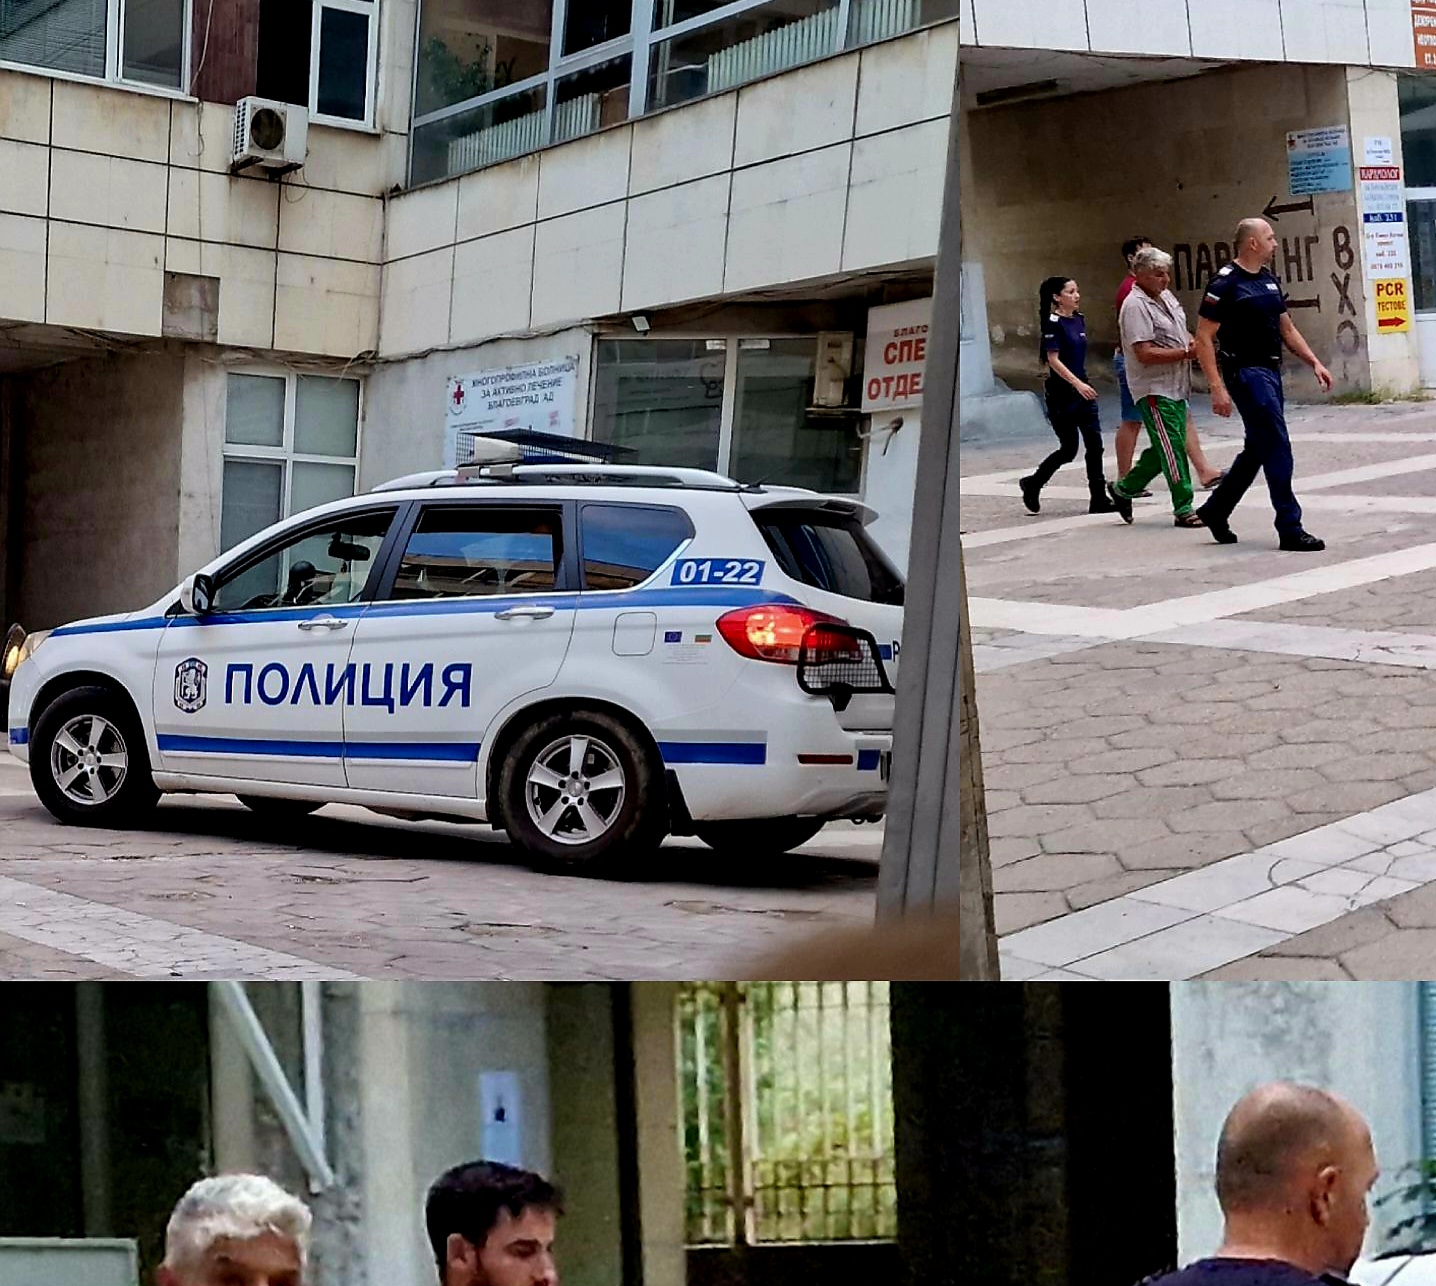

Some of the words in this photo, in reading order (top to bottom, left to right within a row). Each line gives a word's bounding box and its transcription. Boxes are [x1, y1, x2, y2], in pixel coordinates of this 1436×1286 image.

[1173, 235, 1319, 291] ПАРНГ
[1376, 282, 1404, 297] PCR
[680, 561, 760, 583] 01-22
[224, 662, 473, 715] ПОЛИЦИЯ
